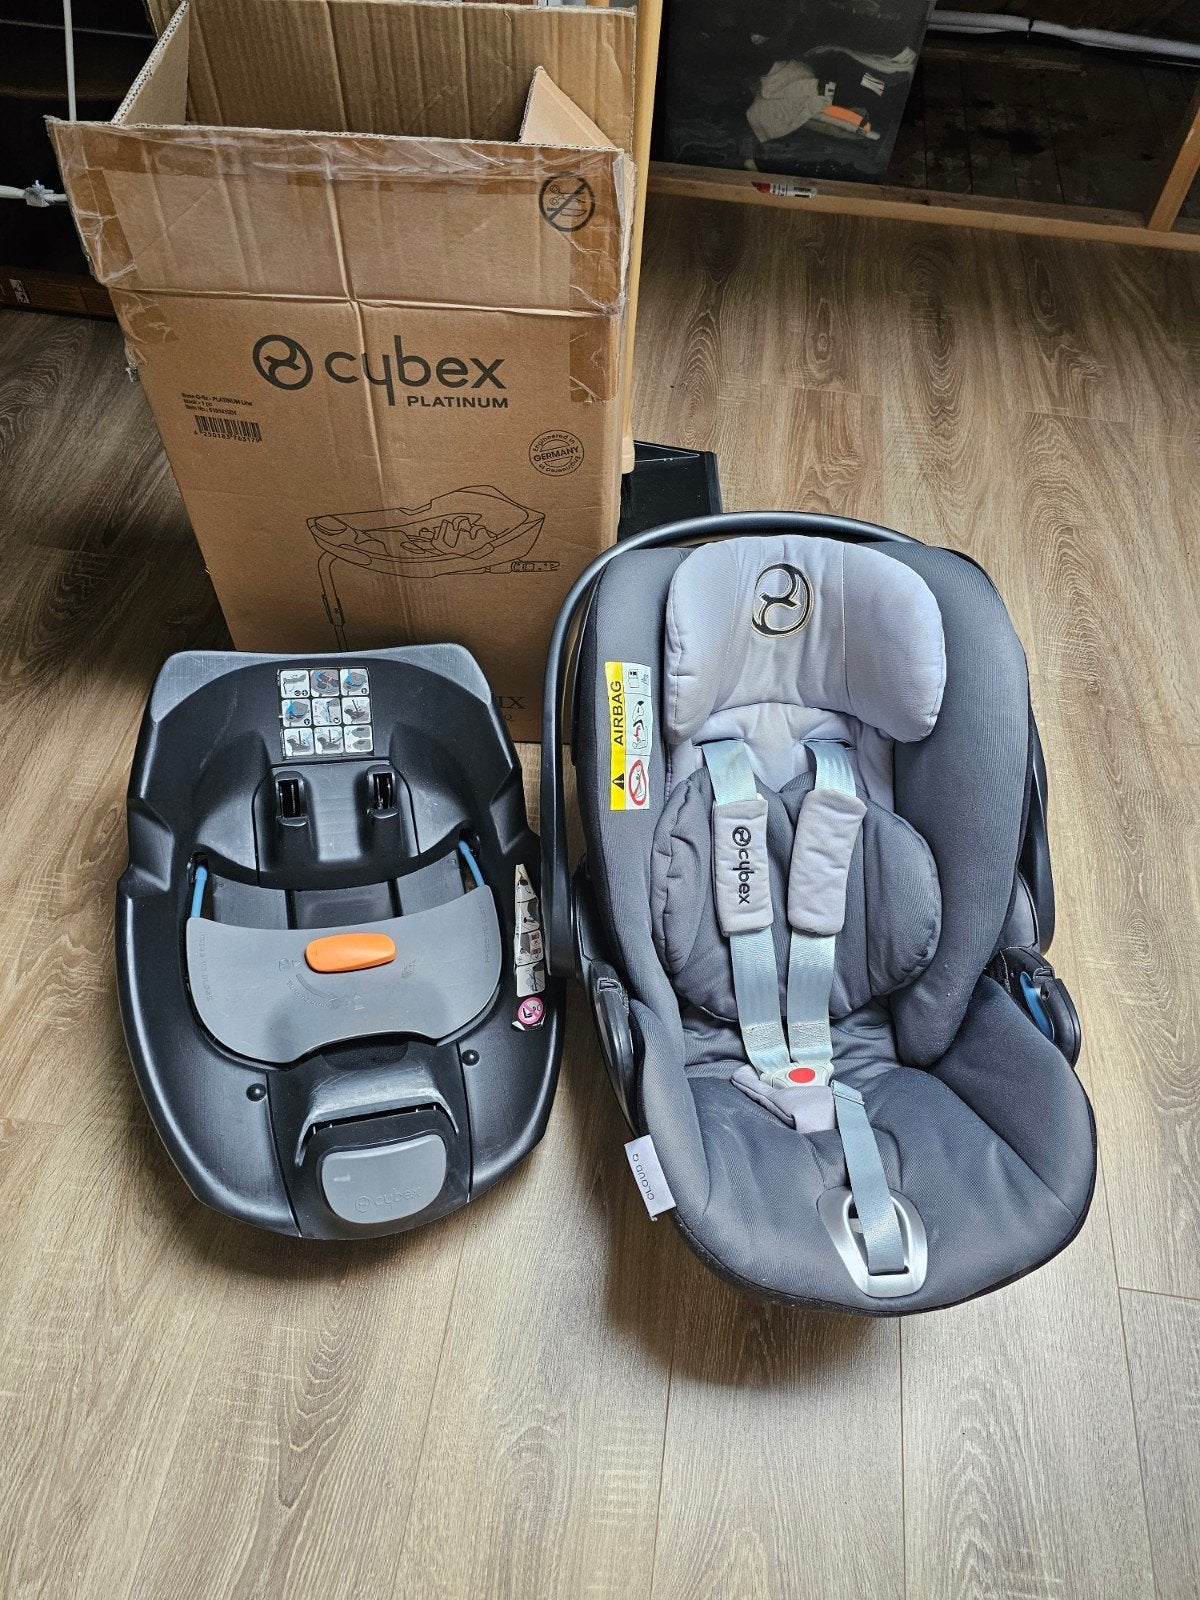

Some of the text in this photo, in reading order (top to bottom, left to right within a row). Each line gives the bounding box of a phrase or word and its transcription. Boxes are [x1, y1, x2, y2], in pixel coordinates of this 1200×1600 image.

[324, 334, 507, 406] cybex
[406, 395, 509, 409] PLATINUM
[533, 445, 579, 462] GERMANY
[610, 680, 624, 746] AIRBAG
[731, 848, 755, 905] cybex
[373, 1187, 421, 1210] cybex
[636, 1164, 655, 1201] CLOUD
